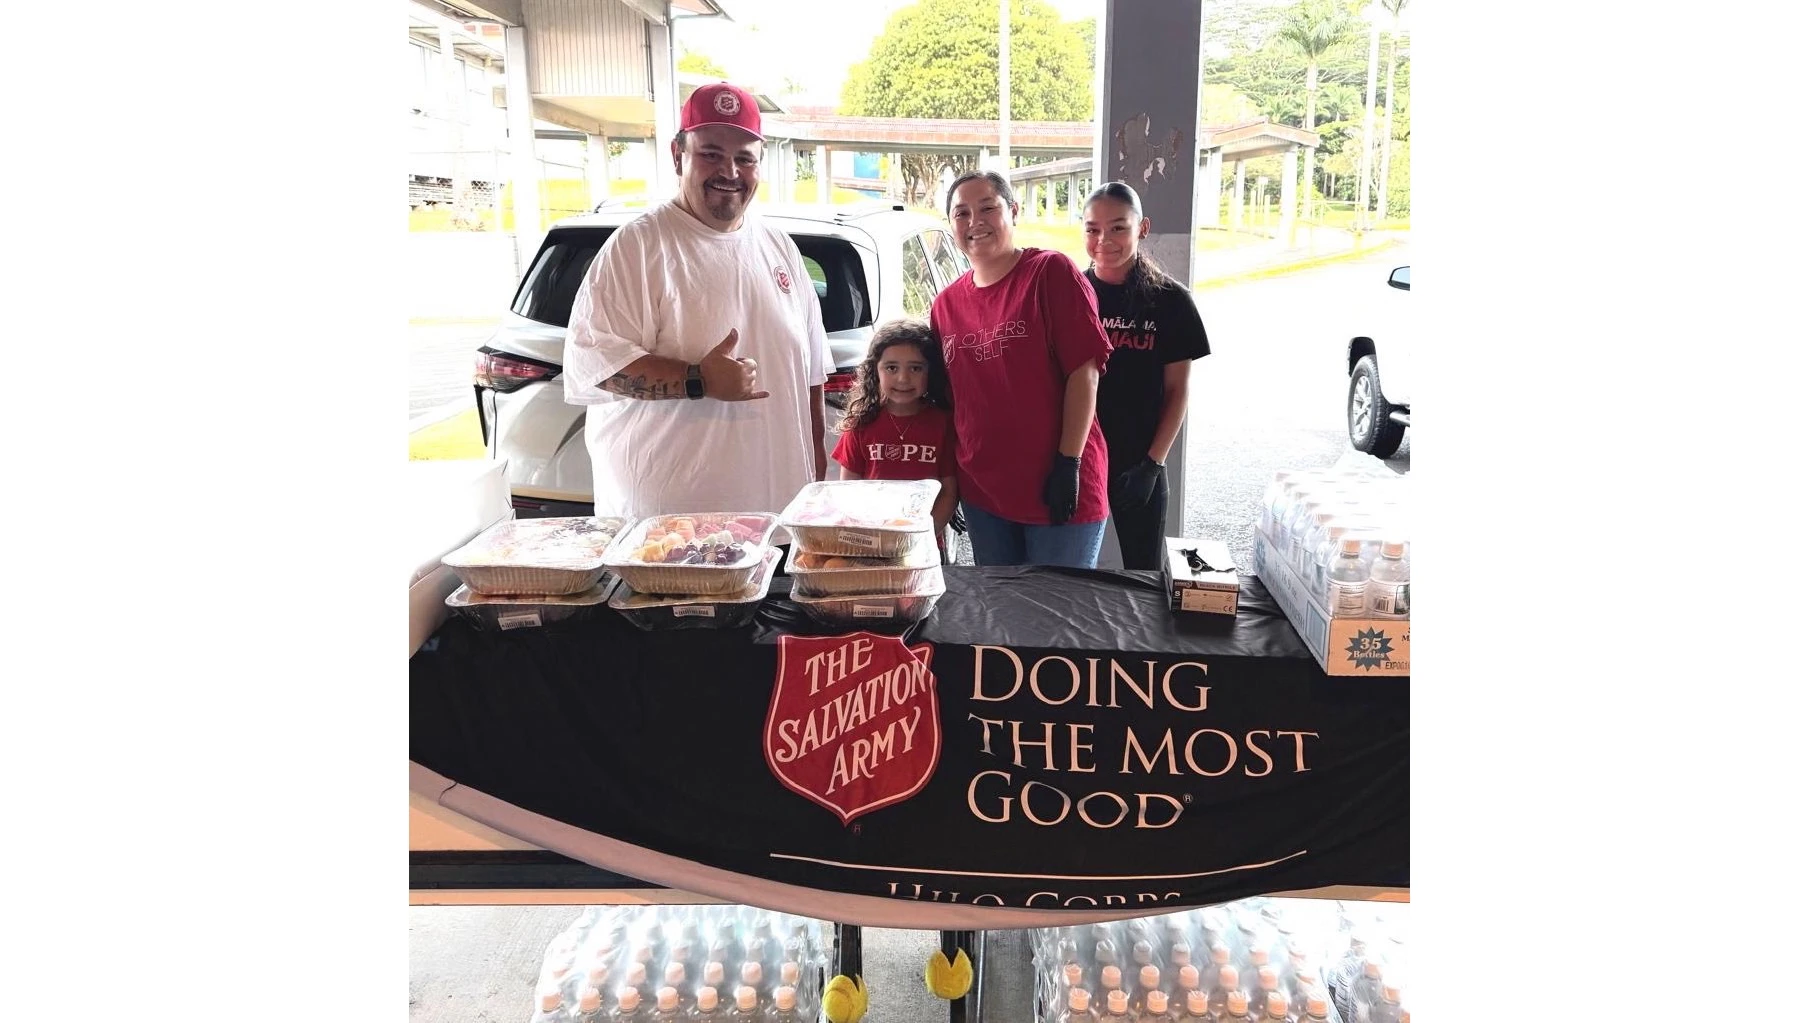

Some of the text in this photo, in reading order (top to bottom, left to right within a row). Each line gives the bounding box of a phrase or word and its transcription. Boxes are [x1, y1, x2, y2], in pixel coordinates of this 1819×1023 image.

[961, 320, 1026, 346] OTHERS
[974, 339, 1009, 362] SELF
[804, 638, 874, 697] THE
[1353, 650, 1385, 659] Bottles
[1360, 637, 1382, 650] 35
[969, 644, 1212, 712] DOING
[775, 659, 928, 763] SALVATION
[825, 706, 921, 796] ARMY
[967, 712, 1320, 777] THE MOST
